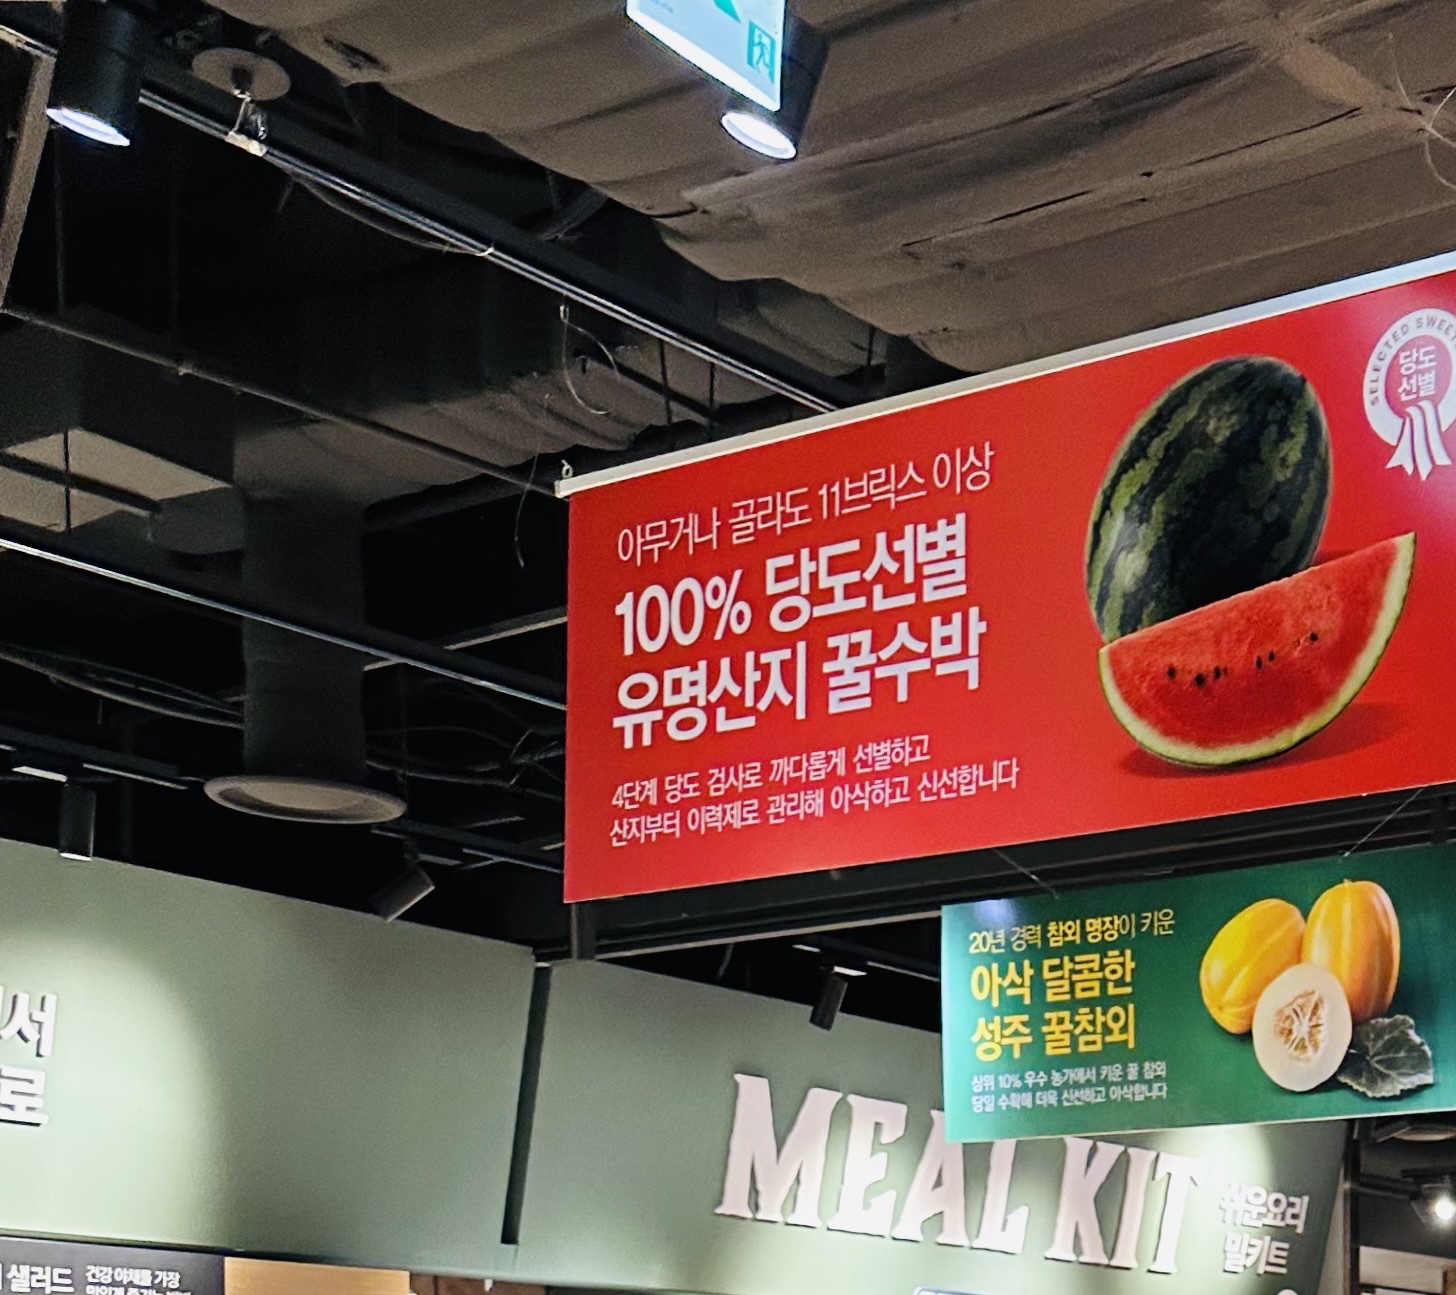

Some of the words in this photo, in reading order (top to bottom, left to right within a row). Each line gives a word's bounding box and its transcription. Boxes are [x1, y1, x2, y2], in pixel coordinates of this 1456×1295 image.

[1370, 323, 1410, 406] SELECTED
[1398, 369, 1436, 402] 선별
[1399, 345, 1438, 376] 당도
[617, 507, 721, 567] 아무거나
[728, 487, 812, 545] 골라도
[817, 460, 928, 521] 11브릭스
[931, 441, 995, 495] 이상
[614, 568, 753, 656] 100%
[765, 511, 968, 633] 당도선별
[612, 640, 807, 750] 유명산지
[822, 605, 987, 715] 꿀수박
[609, 810, 681, 848] 산지부터
[687, 798, 761, 835] 이력제로
[765, 786, 825, 825] 관리해
[830, 774, 911, 812] 아삭하고
[916, 756, 1020, 803] 신선합니다
[610, 777, 658, 811] 4단계
[663, 771, 701, 803] 당도
[707, 761, 762, 797] 검사로
[769, 747, 847, 786] 까다롭게
[852, 733, 931, 774] 선별하고
[968, 928, 1006, 955] 20년
[1010, 924, 1042, 952] 경력
[1047, 919, 1081, 947] 참외
[1084, 913, 1136, 944] 명장이
[1140, 908, 1176, 936] 키운
[970, 958, 1034, 1008] 아삭
[1042, 948, 1136, 1003] 달콤한
[0, 985, 57, 1057] 서
[970, 1014, 1033, 1063] 성주
[1041, 1003, 1136, 1056] 꿀참외
[1025, 1070, 1048, 1089] 우수
[714, 1073, 1029, 1255] MEAL
[1046, 1136, 1200, 1274] KIT
[7, 1264, 75, 1294] 샐러드
[85, 1265, 113, 1283] 건강
[154, 1270, 181, 1289] 가장
[1223, 1232, 1290, 1275] 밀키트
